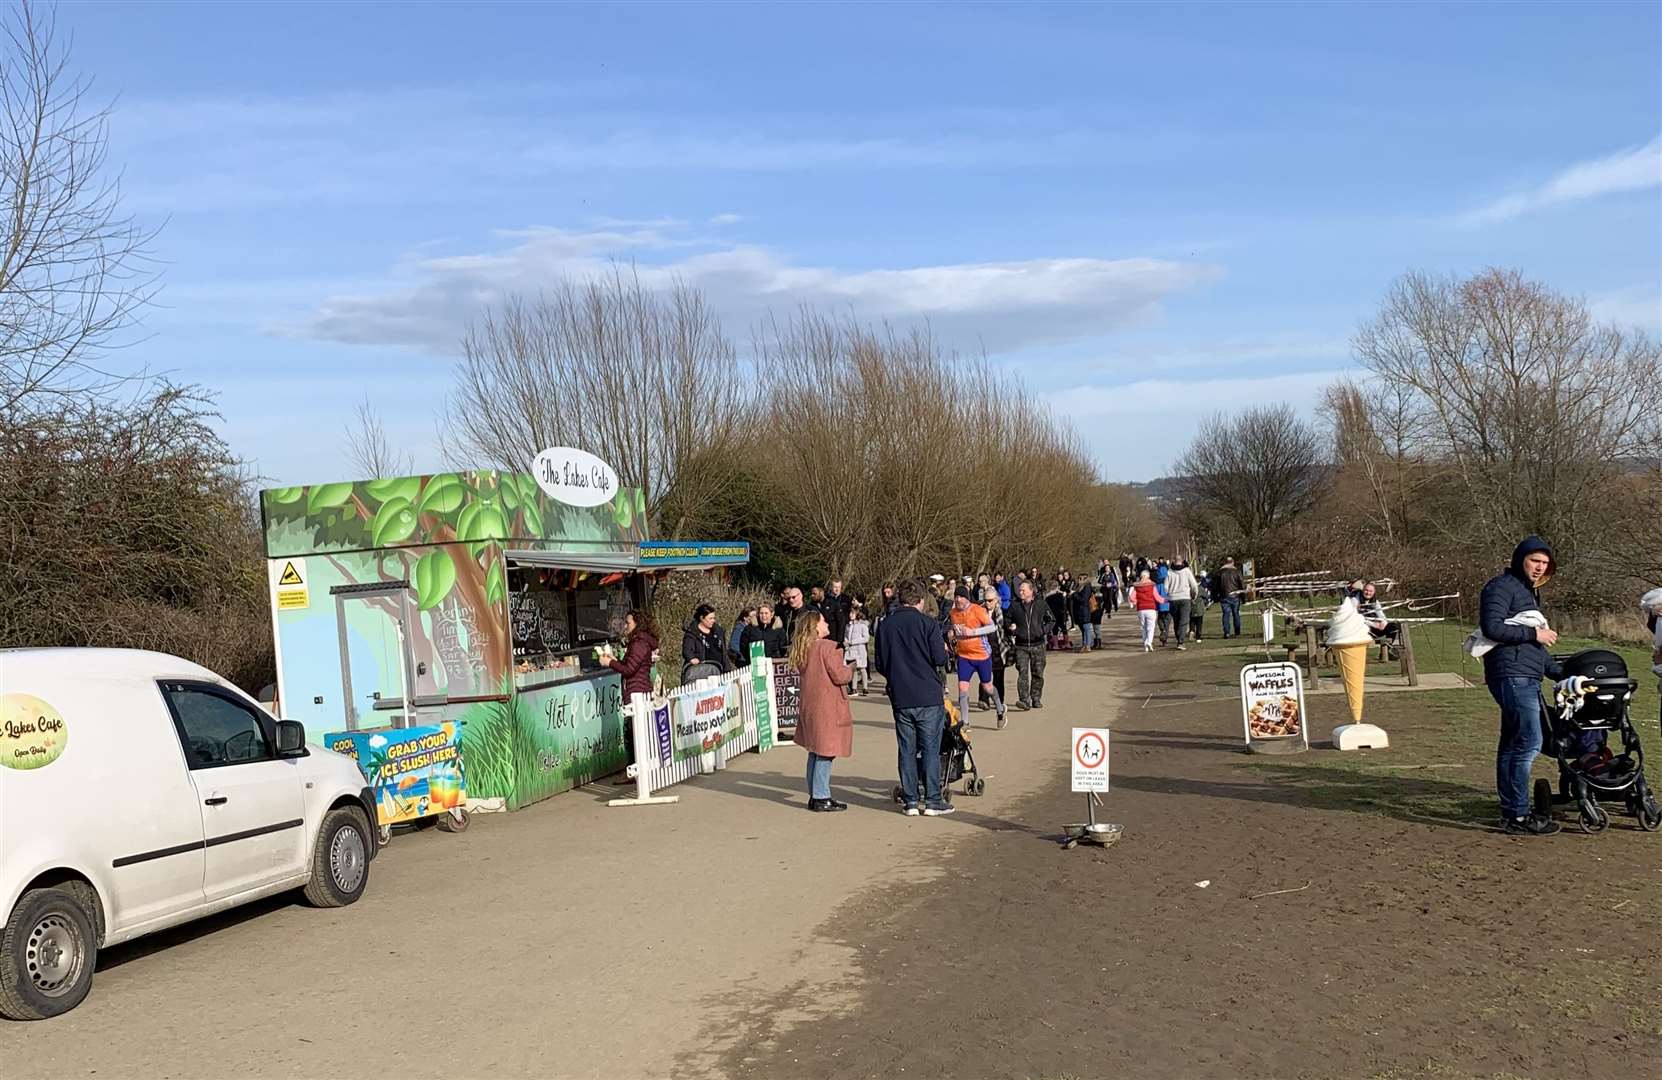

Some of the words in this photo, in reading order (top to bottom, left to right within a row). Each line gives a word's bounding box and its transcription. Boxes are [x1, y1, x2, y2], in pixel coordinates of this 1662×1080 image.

[541, 457, 560, 485] The
[564, 460, 589, 488] Lakes
[592, 465, 610, 495] Cafe
[640, 547, 656, 557] PLEASE
[1248, 678, 1294, 690] WAFFLES
[545, 695, 569, 731] Hot
[5, 720, 36, 739] Lakes
[38, 716, 63, 733] Cafe
[14, 748, 29, 758] Open
[29, 746, 46, 756] Daily
[333, 739, 355, 751] COOL
[387, 742, 418, 759] GRAB
[418, 733, 447, 750] YOUR
[380, 762, 399, 778] ICE
[401, 755, 430, 773] SLUSH
[432, 746, 457, 763] HERE
